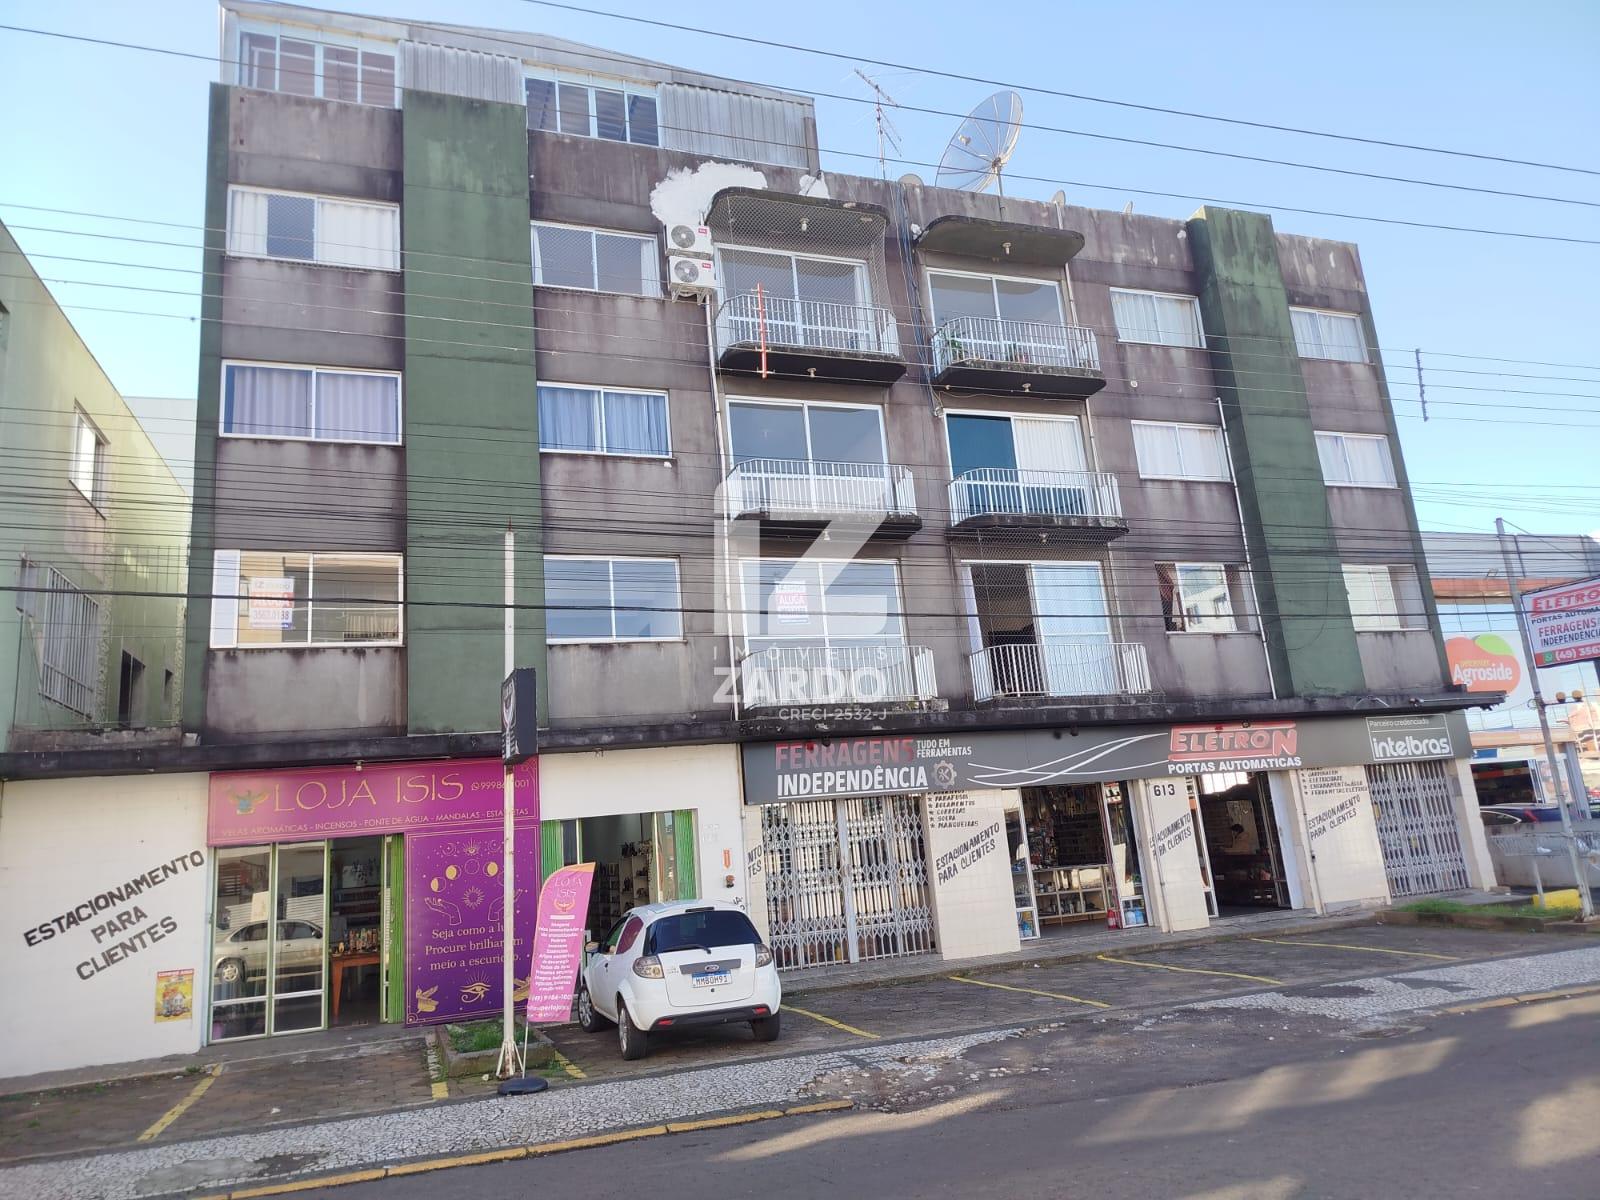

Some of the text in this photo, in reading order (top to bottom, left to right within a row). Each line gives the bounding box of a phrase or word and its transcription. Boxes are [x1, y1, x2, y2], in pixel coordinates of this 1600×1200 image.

[1532, 614, 1562, 624] PORTAS
[1538, 617, 1597, 638] FERRAGENS
[1453, 663, 1513, 686] Agroside
[775, 736, 916, 770] FERRAGENS
[916, 738, 950, 749] TUDO EM
[916, 746, 972, 758] FERRAMENTAS
[1170, 726, 1298, 757] ELETRON
[1372, 735, 1450, 758] intelbras
[1167, 756, 1302, 775] PORTAS AUTOMATICAS
[777, 765, 929, 796] INDEPENDÊNCIA
[1153, 783, 1176, 797] 613
[274, 773, 464, 813] LOJA ISIS
[315, 820, 357, 831] INCENSOS
[364, 817, 391, 827] FONTE
[392, 816, 402, 825] DE
[436, 811, 480, 822] MANDALAS
[1308, 794, 1361, 830] ESTACIONAMENTO
[1310, 807, 1357, 841] PARA CLIENTES
[935, 822, 1000, 871] ESTACIONAMENTO
[938, 838, 996, 886] PARA CLIENTES
[23, 850, 205, 947] ESTACIONAMENTO
[91, 906, 148, 944] PARA
[432, 929, 454, 940] Seja
[457, 926, 486, 936] como
[488, 925, 495, 933] a
[75, 916, 178, 981] CLIENTES
[425, 945, 466, 956] Procure
[430, 960, 457, 971] meio
